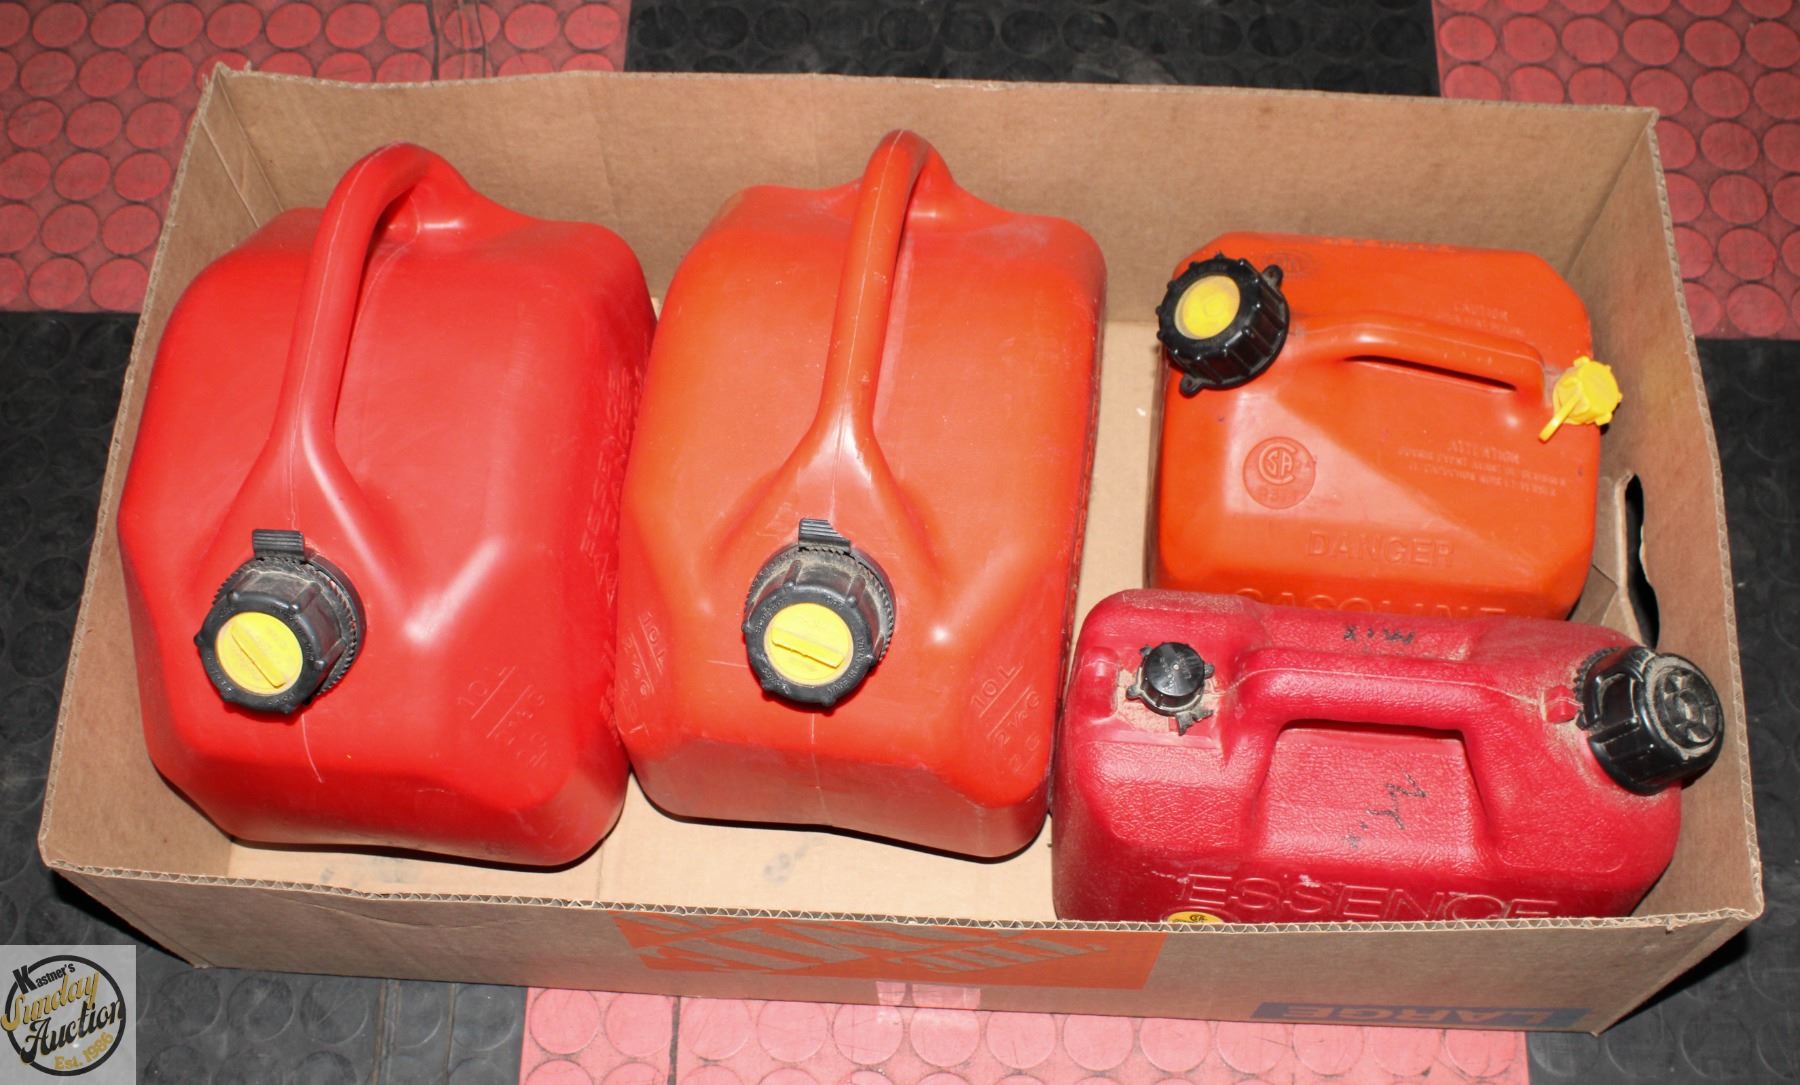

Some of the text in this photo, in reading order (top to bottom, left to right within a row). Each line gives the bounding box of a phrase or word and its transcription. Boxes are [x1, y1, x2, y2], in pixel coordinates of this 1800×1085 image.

[1307, 529, 1455, 567] DANGER
[970, 678, 997, 709] 10
[1180, 873, 1558, 919] ESSENCE
[1284, 1005, 1555, 1024] LARGE
